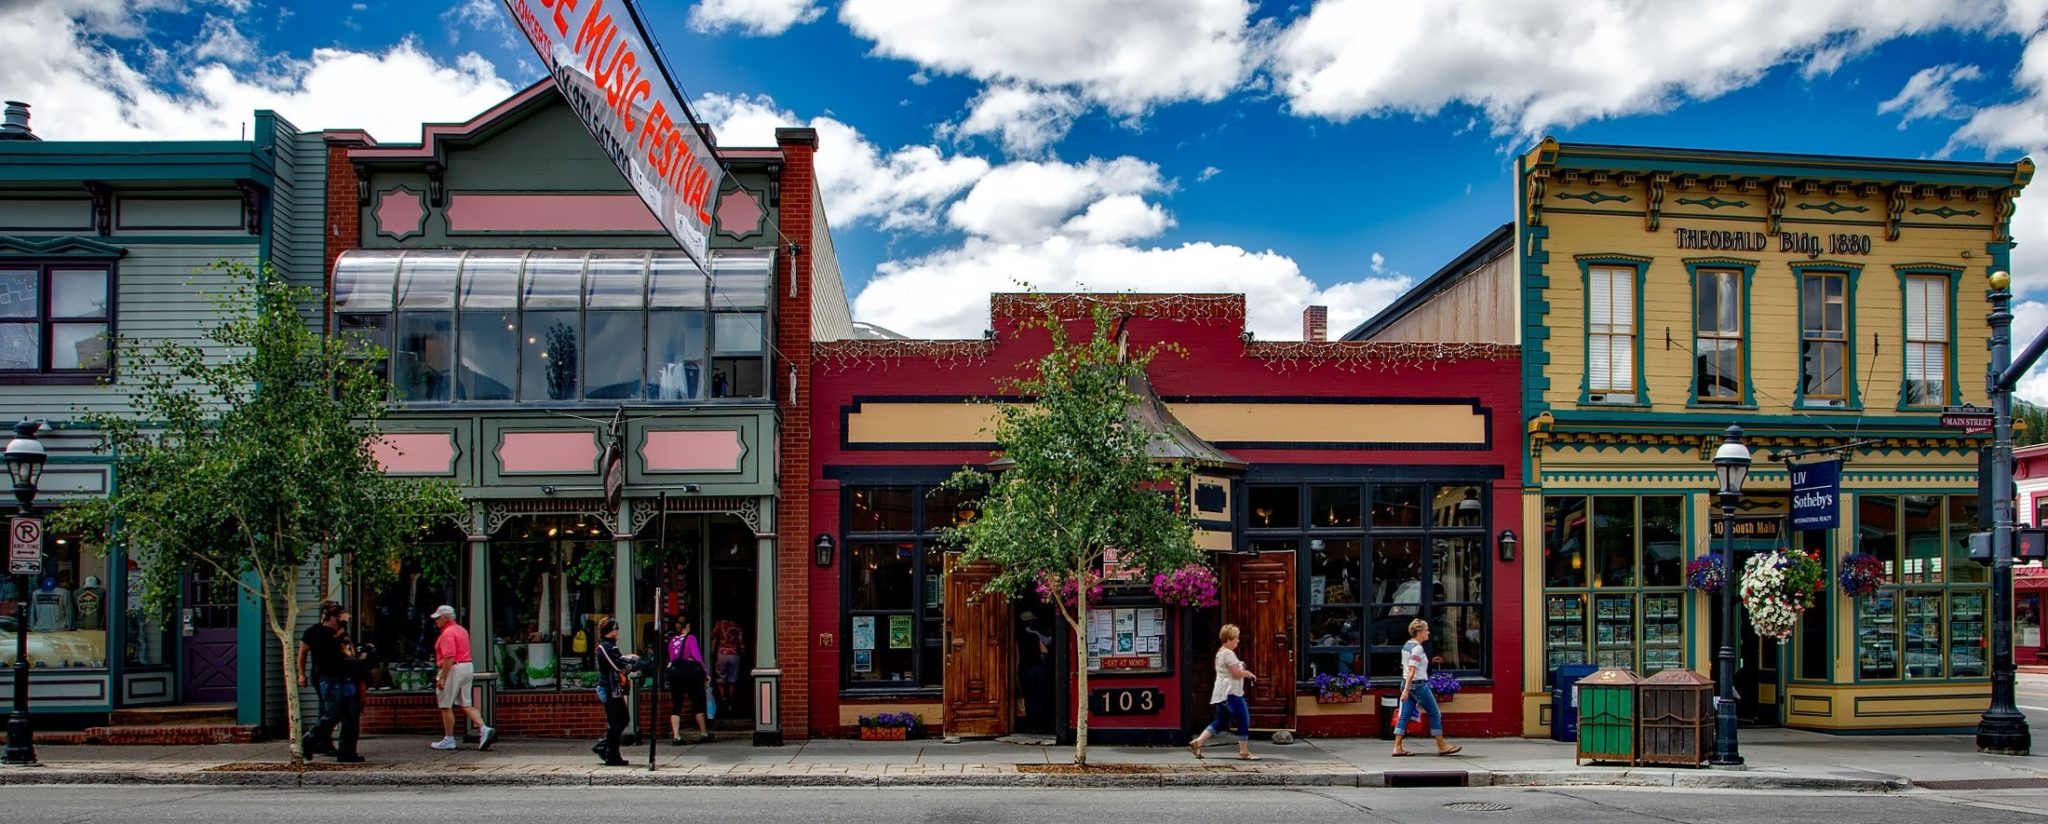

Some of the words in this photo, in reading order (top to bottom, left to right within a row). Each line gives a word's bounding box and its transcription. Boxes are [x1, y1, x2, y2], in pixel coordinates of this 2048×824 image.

[540, 0, 578, 39] E
[573, 0, 651, 133] MUSIC
[638, 99, 712, 226] FESTIVAL
[1674, 228, 1767, 251] THEOBALD
[1780, 232, 1824, 259] Bldg.
[1830, 233, 1871, 255] 1880
[1947, 417, 1965, 425] MAIN
[1965, 418, 1992, 426] STREET
[1793, 471, 1807, 485] LIV
[1793, 491, 1833, 510] Sotheby's
[1756, 520, 1776, 534] Main
[1102, 690, 1153, 713] 103
